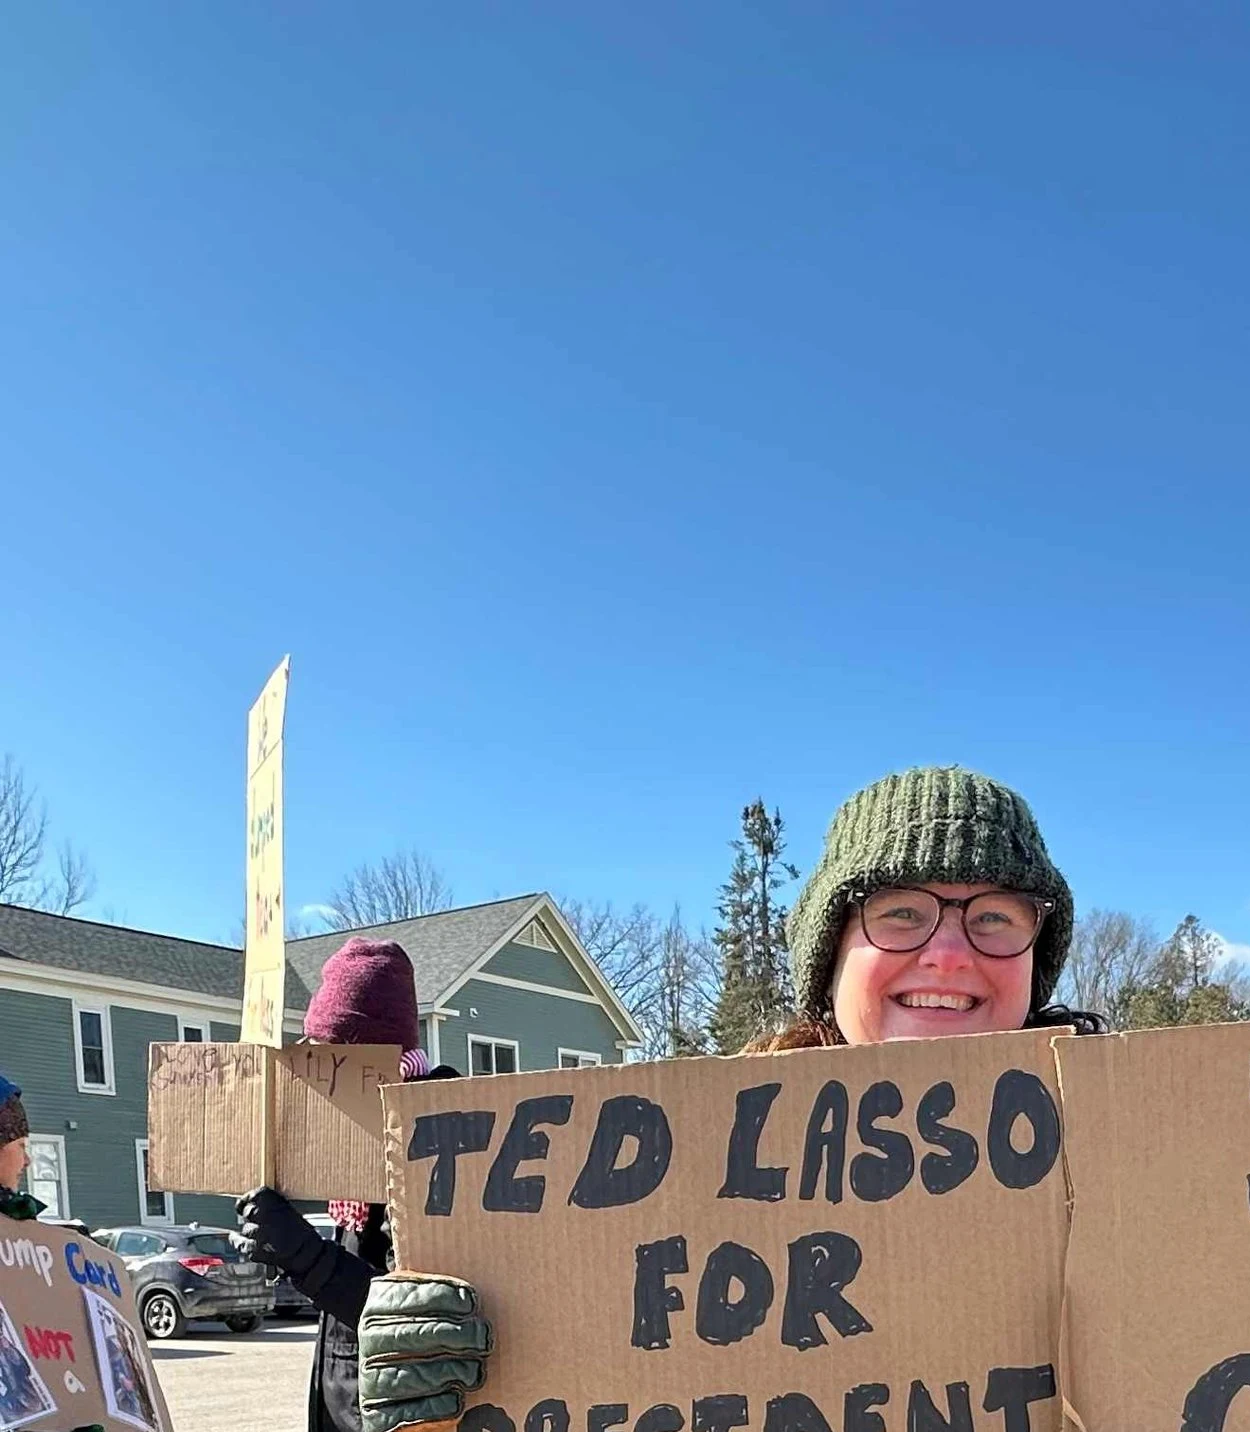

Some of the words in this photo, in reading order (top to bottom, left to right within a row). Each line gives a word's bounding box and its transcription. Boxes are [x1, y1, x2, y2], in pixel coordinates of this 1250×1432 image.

[407, 1094, 673, 1216] TED
[716, 1069, 1062, 1204] LASSO
[65, 1242, 122, 1297] Card
[630, 1230, 874, 1351] FOR
[23, 1325, 76, 1363] NOT
[63, 1370, 86, 1394] a
